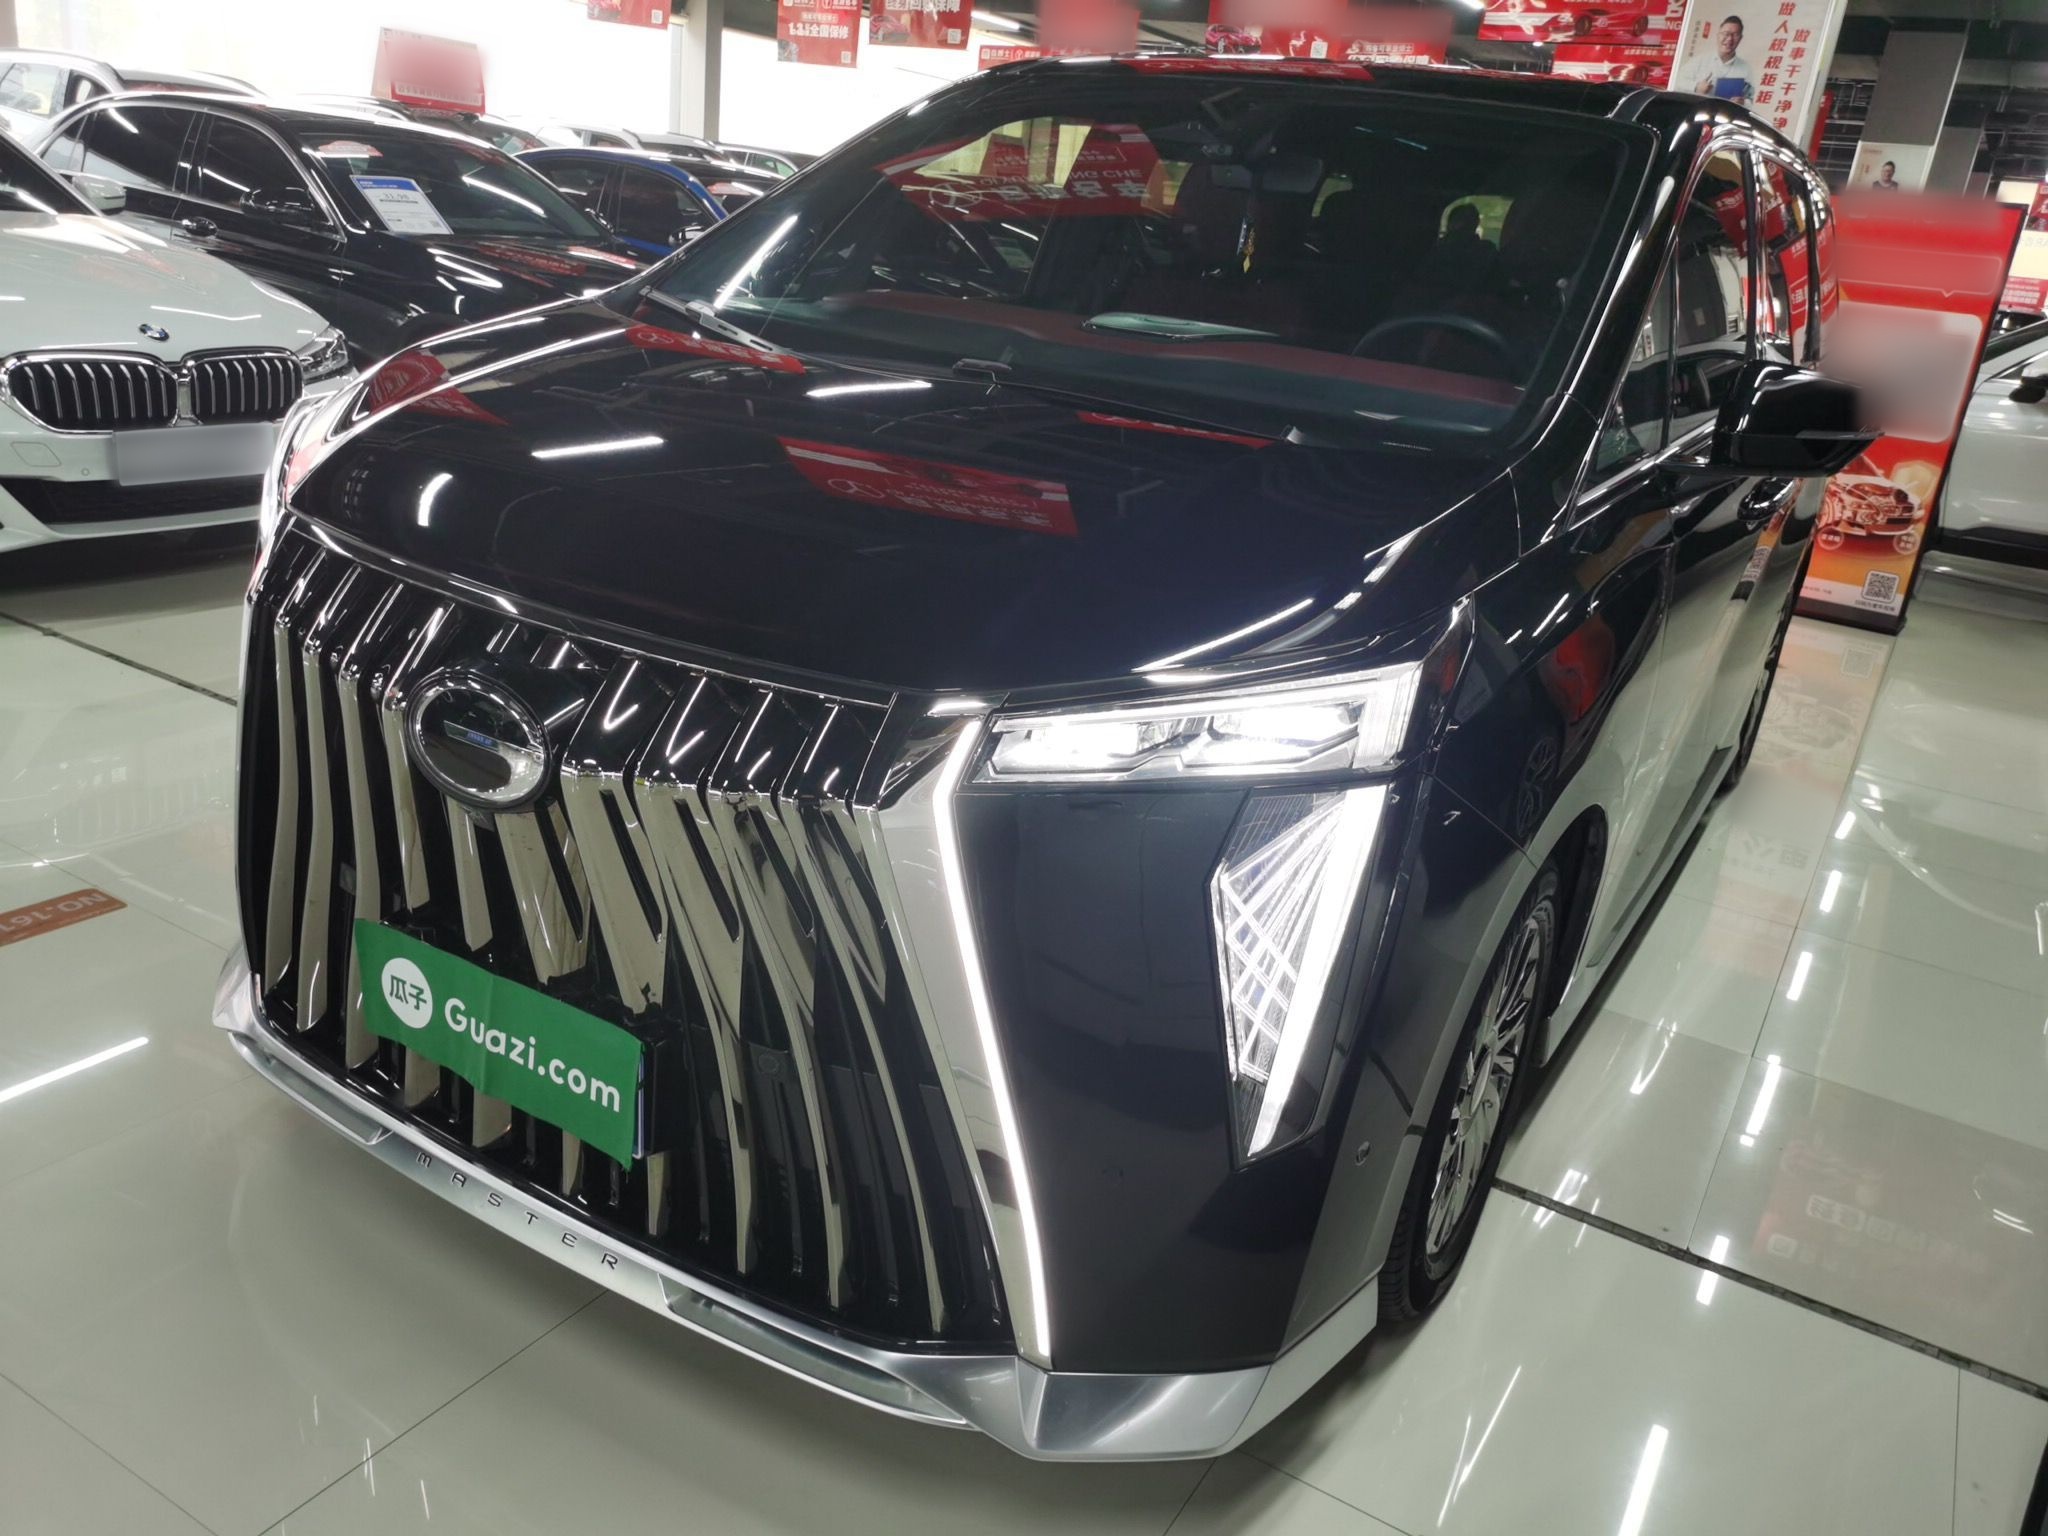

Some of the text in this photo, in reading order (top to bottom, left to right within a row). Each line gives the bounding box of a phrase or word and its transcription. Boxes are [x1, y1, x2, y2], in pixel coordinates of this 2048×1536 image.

[1755, 1, 1796, 104] 做人规规矩矩
[1773, 28, 1811, 129] 做事干干净净
[389, 974, 428, 1010] 瓜子
[444, 997, 621, 1113] Guazi.com
[416, 1151, 619, 1270] MASTER
